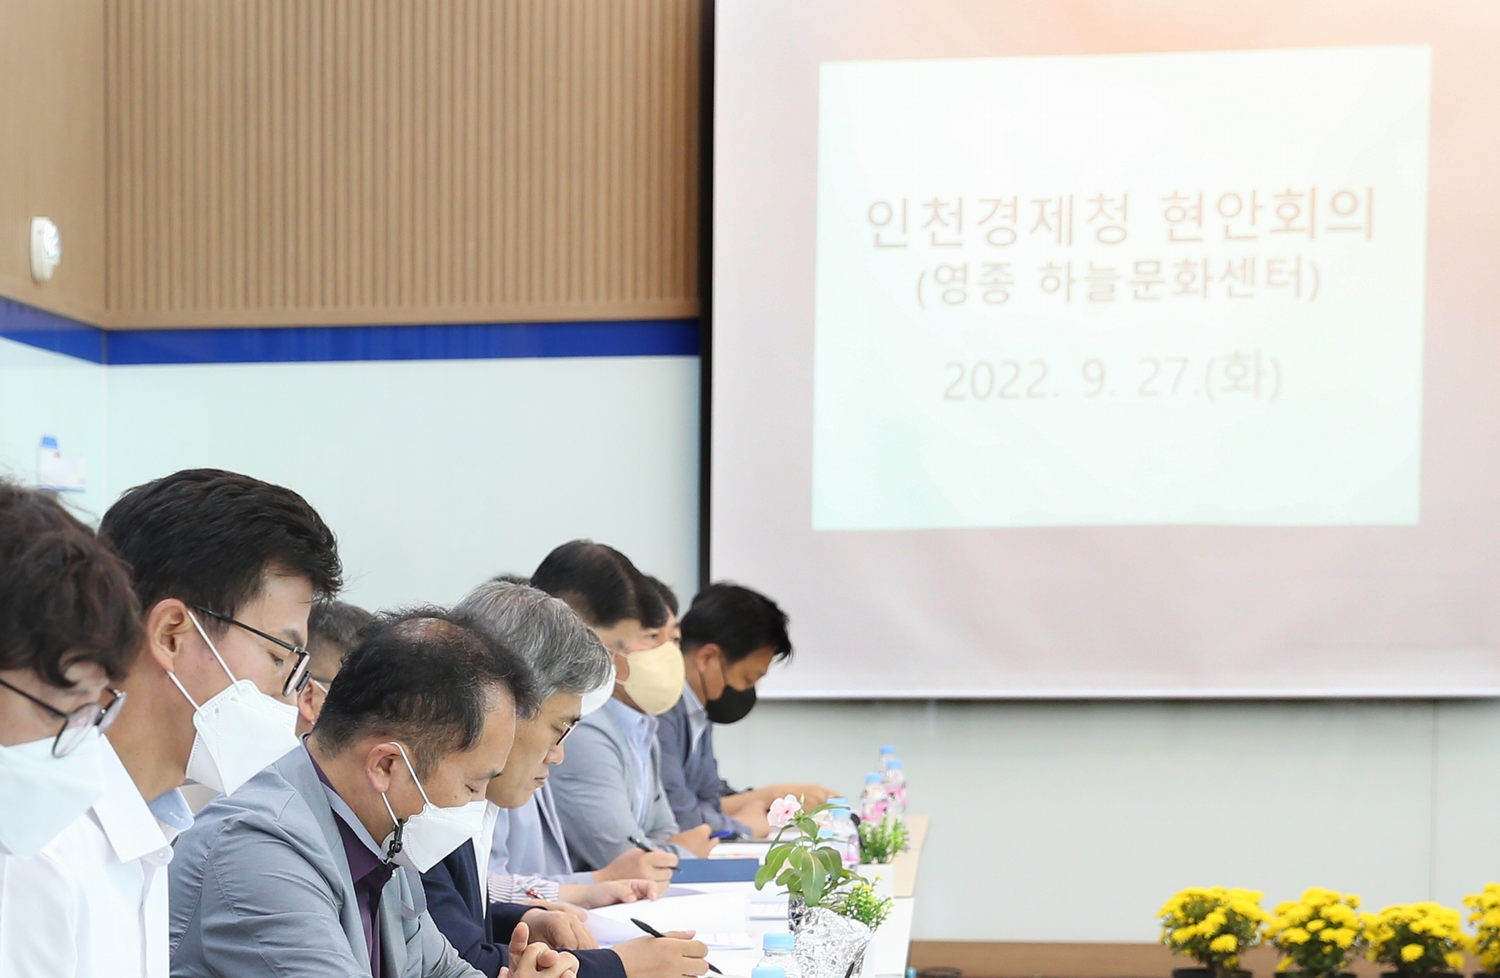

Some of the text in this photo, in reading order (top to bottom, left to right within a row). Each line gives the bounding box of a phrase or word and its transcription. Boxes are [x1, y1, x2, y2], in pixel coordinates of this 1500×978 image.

[866, 186, 1377, 250] 인천경제청 현안회의
[916, 255, 1322, 310] (영종 하늘문화센터)
[942, 349, 1283, 404] 2022. 9. 27.(화)
